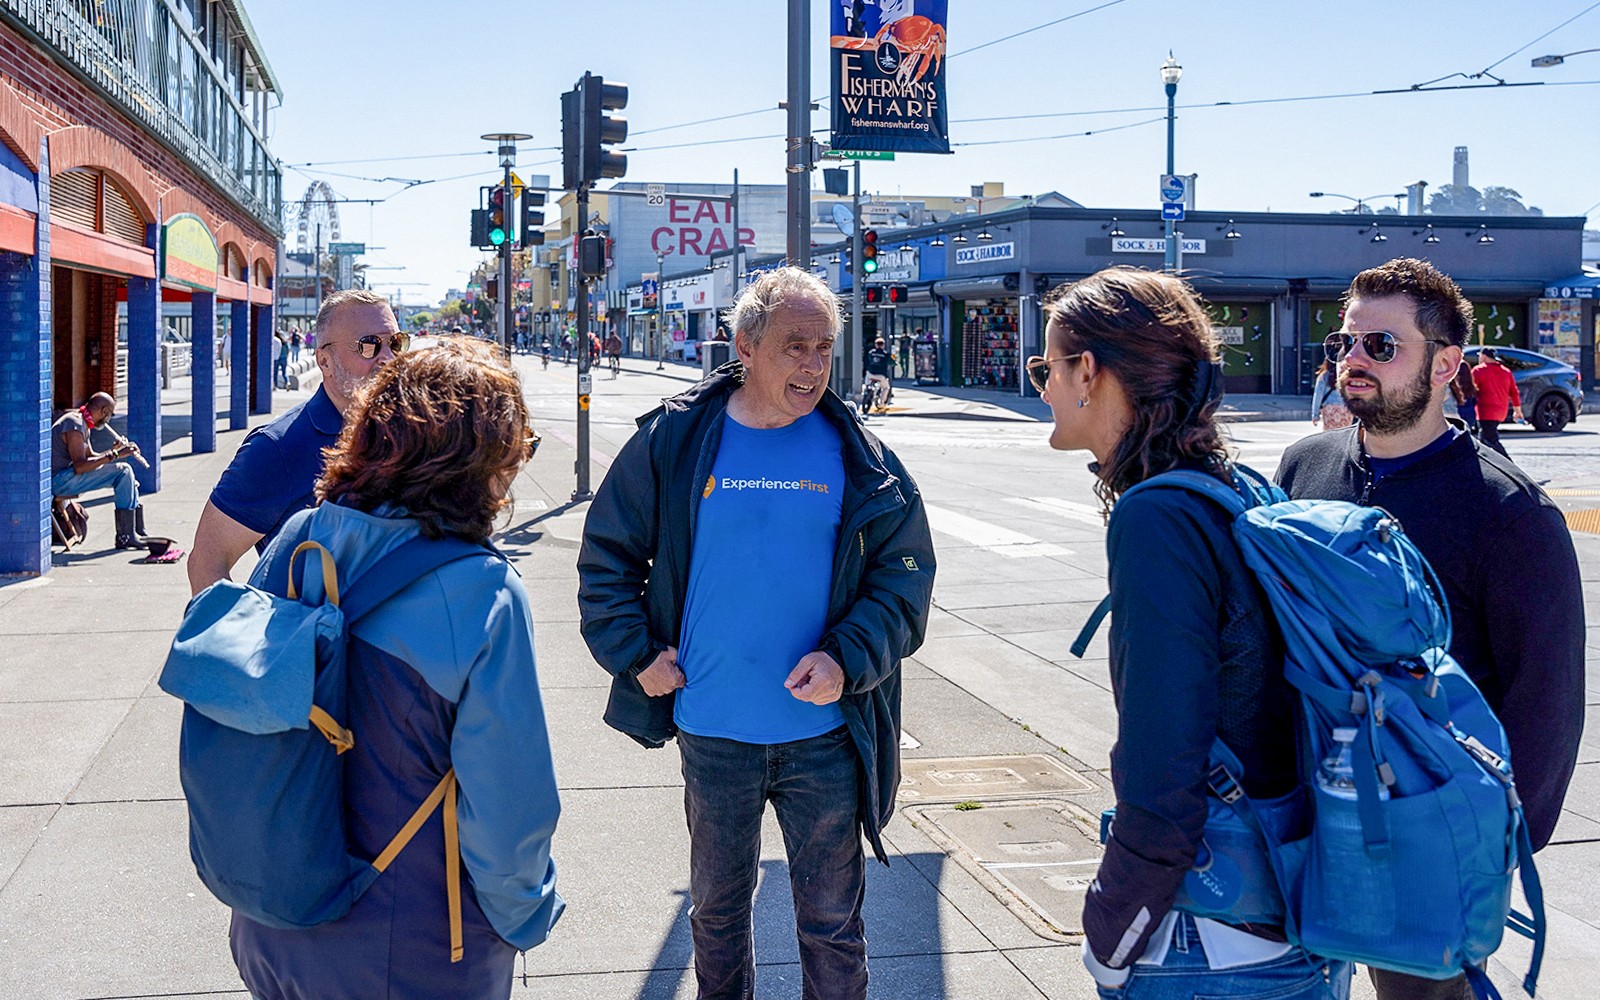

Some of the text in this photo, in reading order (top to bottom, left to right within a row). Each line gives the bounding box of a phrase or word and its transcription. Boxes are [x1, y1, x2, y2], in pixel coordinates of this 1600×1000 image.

[841, 53, 937, 100] FISHERMAN'S
[841, 96, 938, 118] WHARF
[851, 117, 930, 132] fishermanswharf.org
[649, 195, 664, 205] 20
[957, 245, 1012, 262] SOCK HARBOR
[1117, 241, 1201, 251] SOCK HBOR
[721, 477, 829, 494] ExperienceFirst
